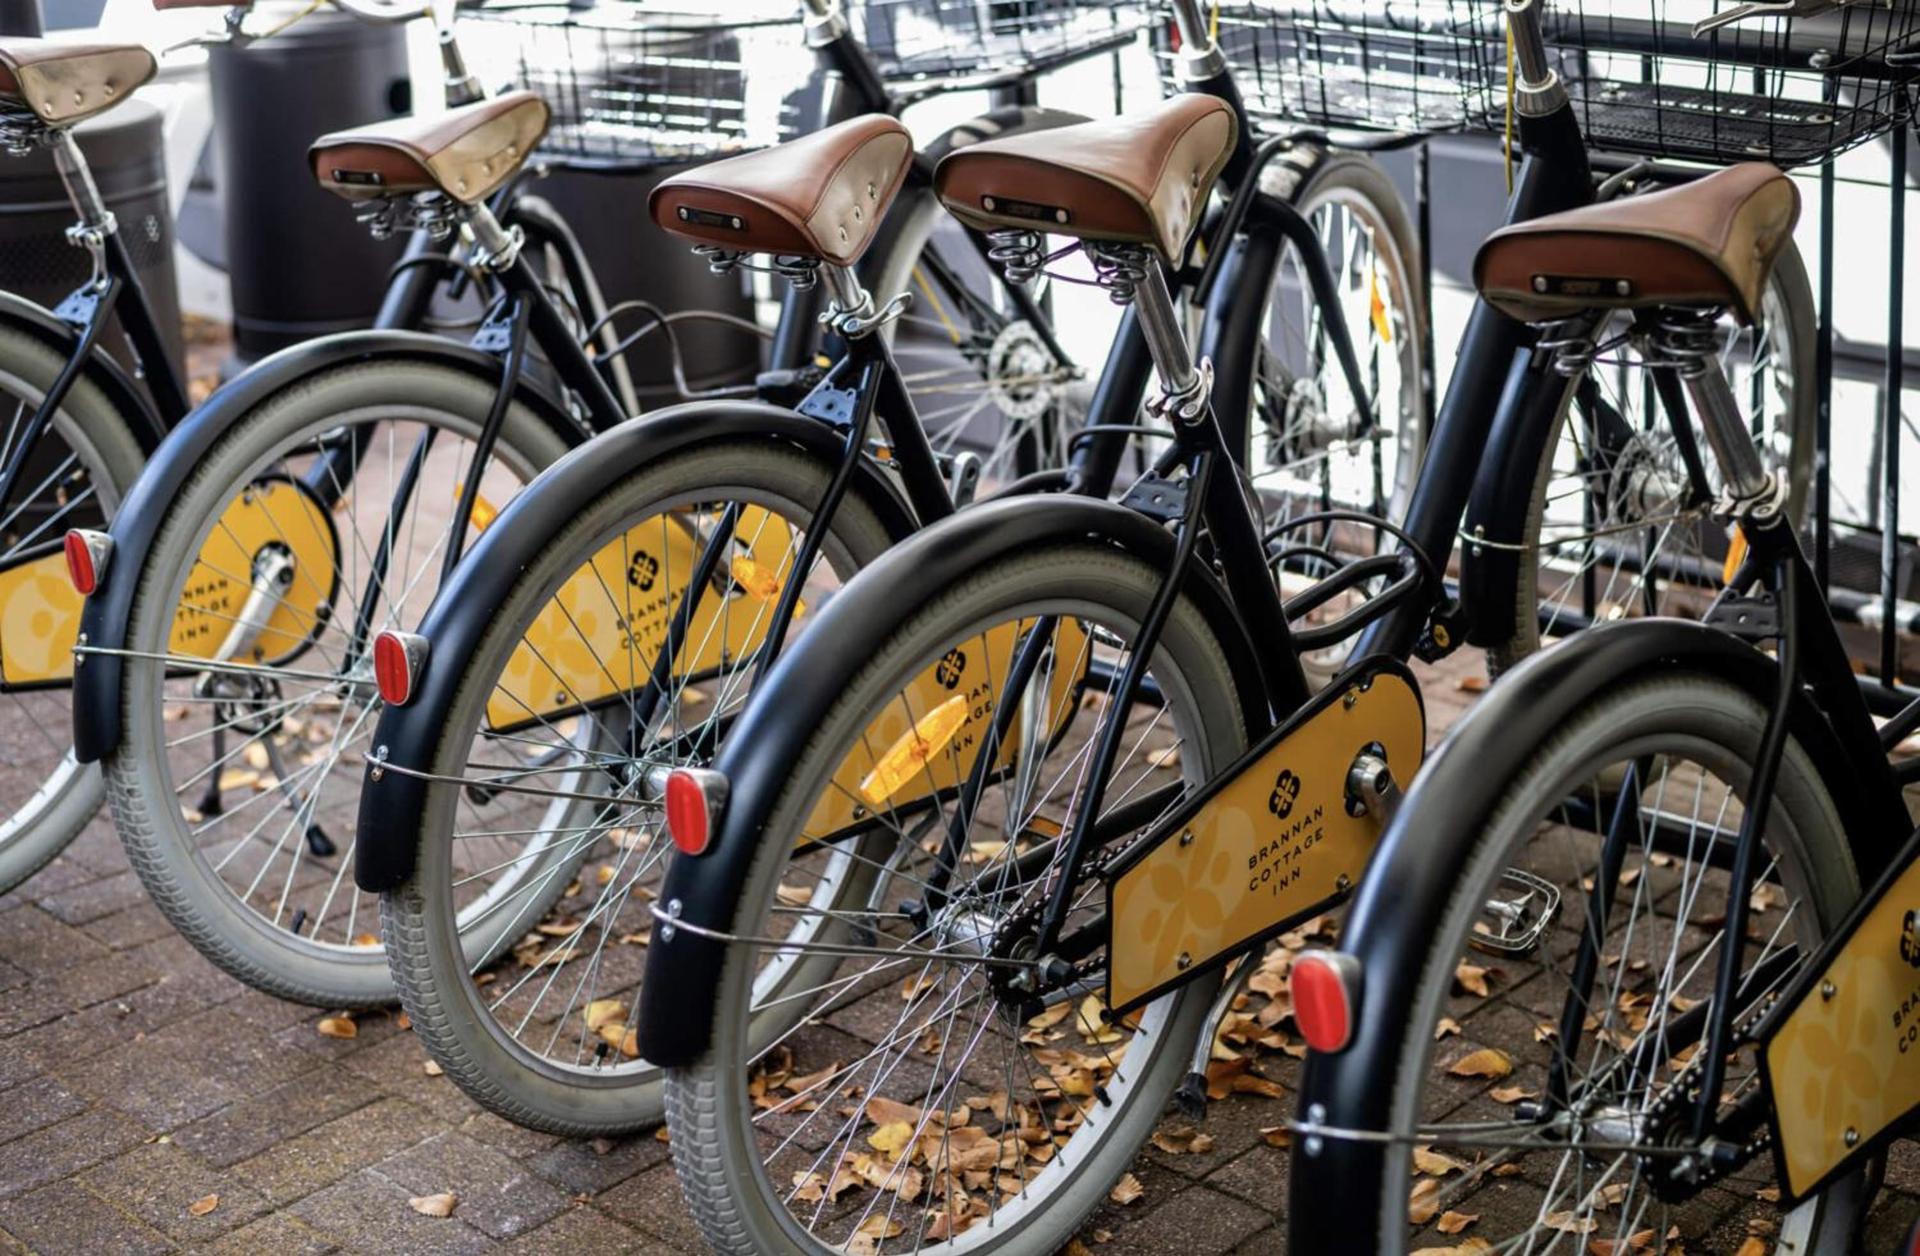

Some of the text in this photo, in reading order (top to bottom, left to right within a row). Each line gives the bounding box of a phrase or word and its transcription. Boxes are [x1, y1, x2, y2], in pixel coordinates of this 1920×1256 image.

[183, 580, 228, 599] NNAN
[180, 624, 209, 643] INN
[945, 734, 973, 760] INN
[1249, 805, 1323, 869] BRANNAN
[1249, 827, 1324, 892] COTTAGE
[1273, 867, 1300, 896] INN
